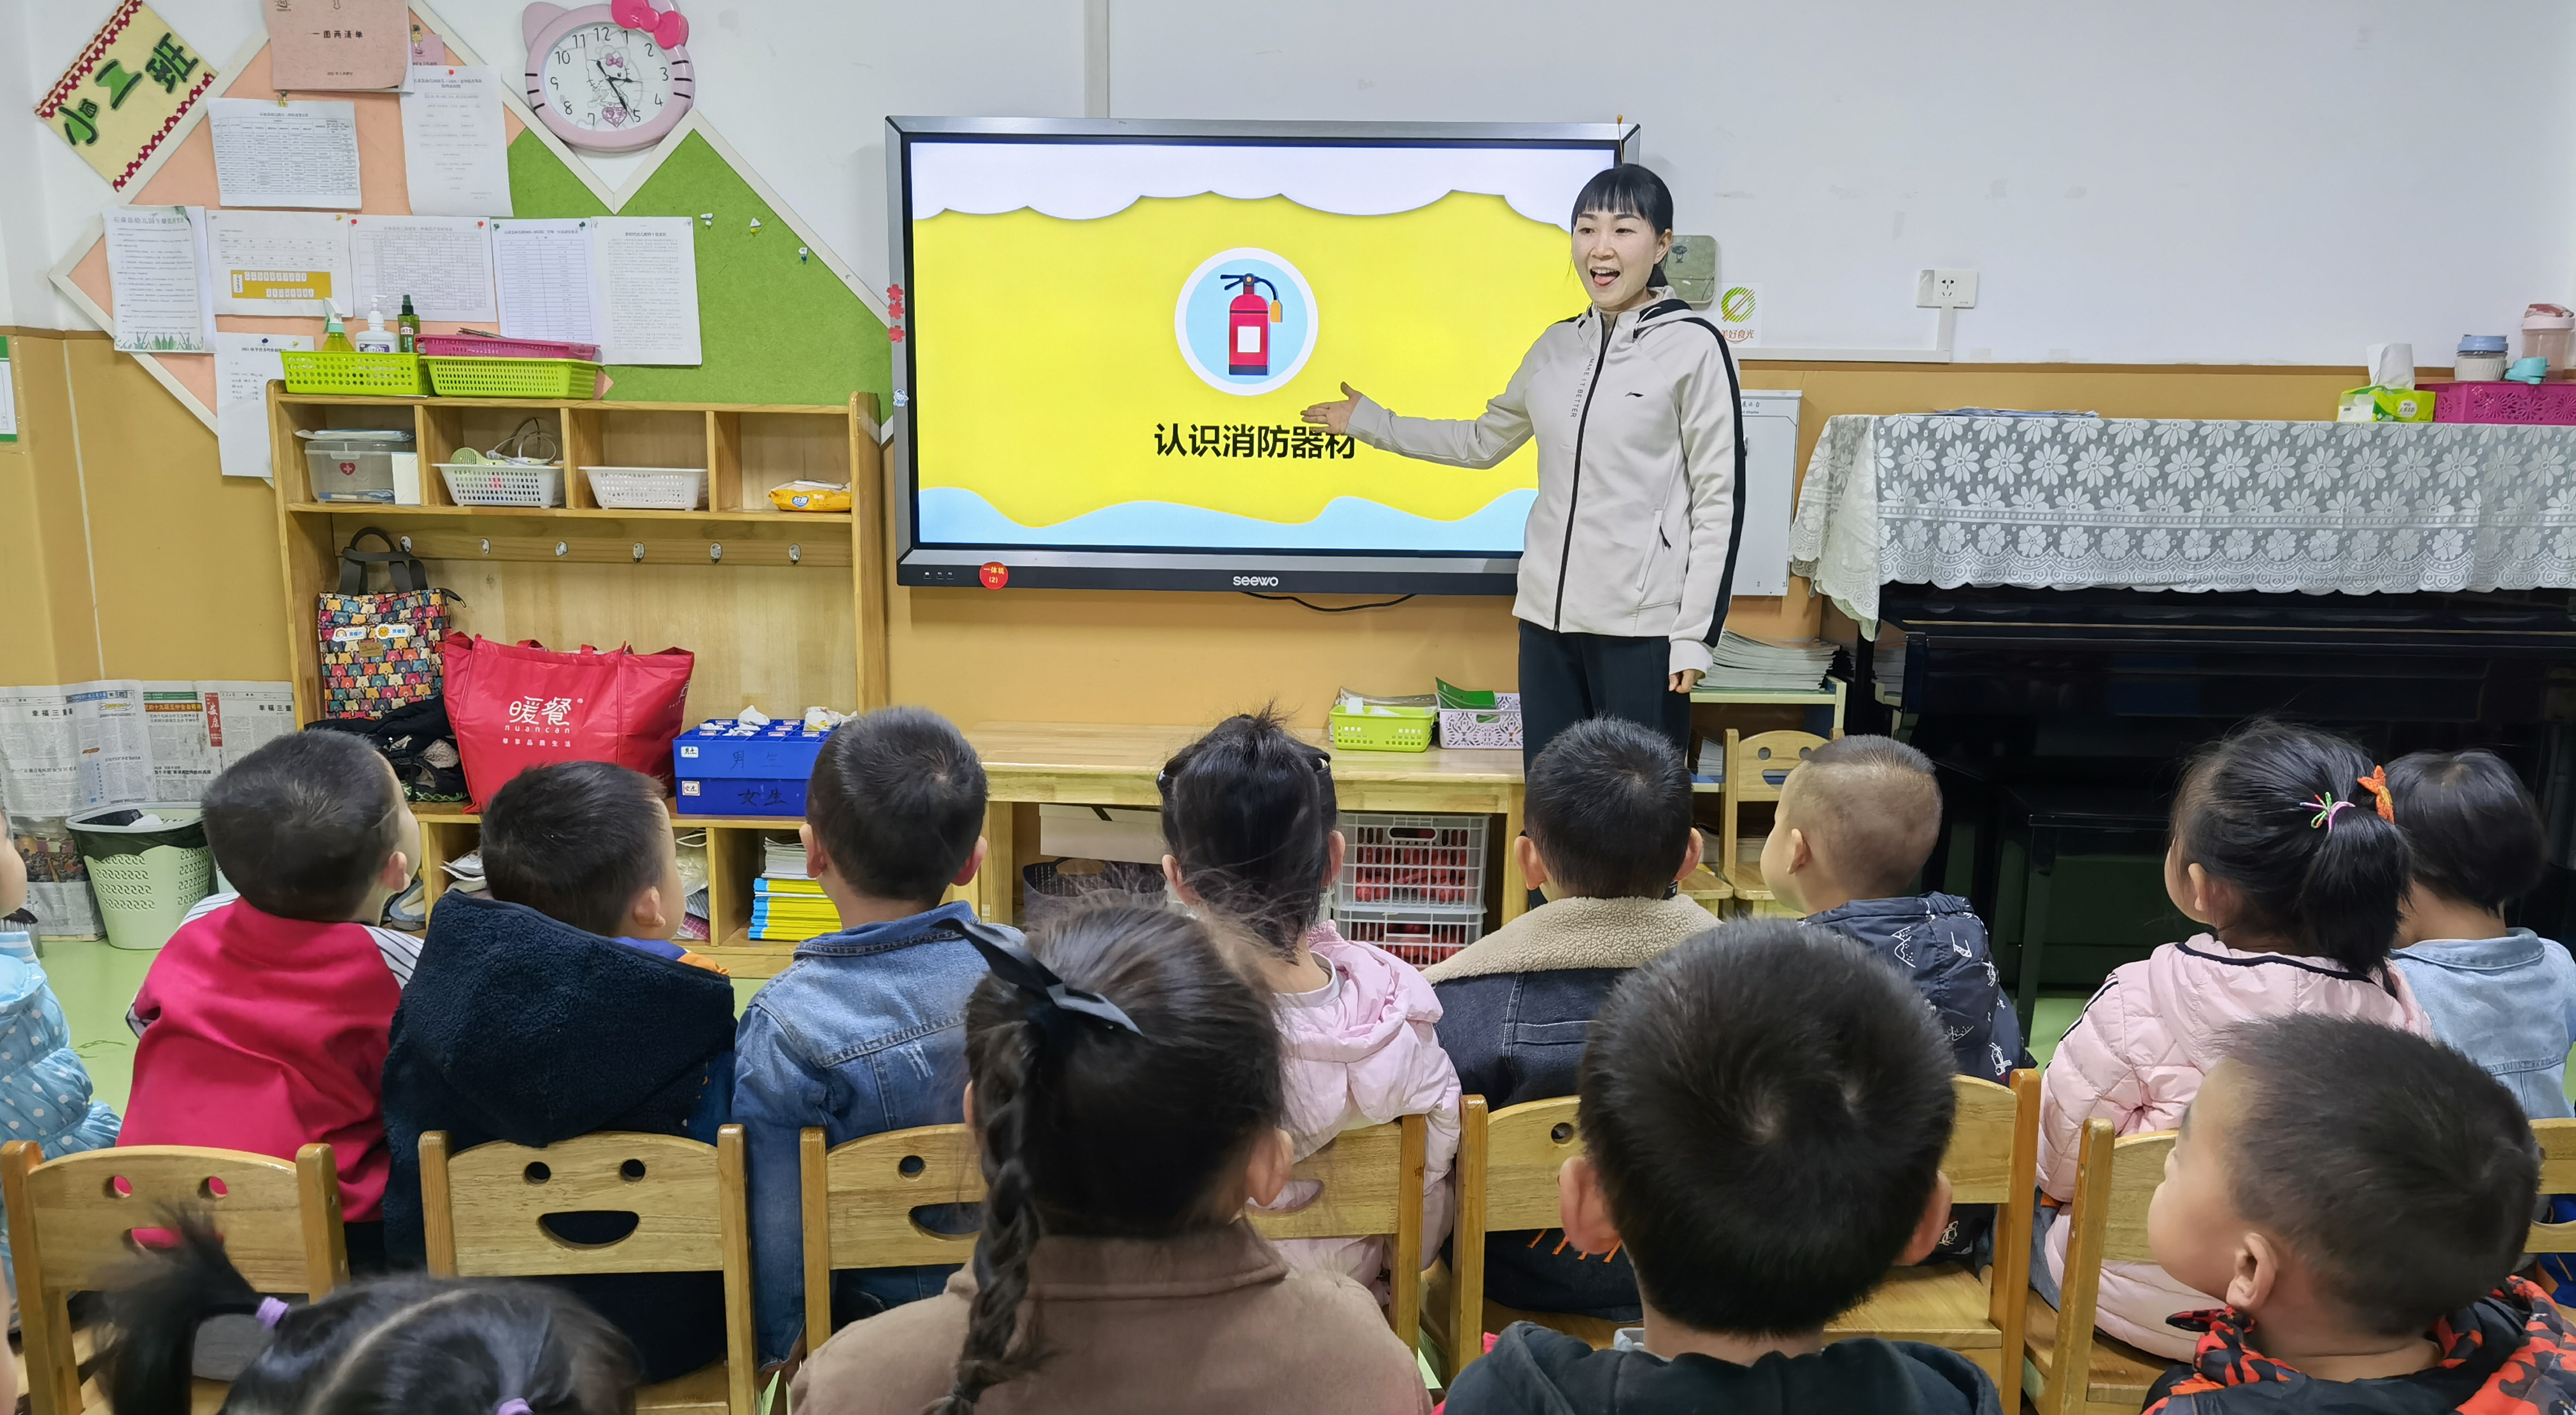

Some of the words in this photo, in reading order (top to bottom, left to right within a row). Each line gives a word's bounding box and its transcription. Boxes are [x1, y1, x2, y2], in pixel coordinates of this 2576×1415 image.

[572, 34, 586, 48] 11
[593, 27, 611, 41] 12
[623, 31, 629, 44] 1
[555, 50, 570, 64] 10
[644, 43, 654, 57] 2
[660, 67, 669, 81] 3
[59, 32, 199, 146] 小二班
[550, 77, 559, 90] 9
[655, 94, 663, 106] 4
[563, 101, 572, 115] 8
[588, 113, 595, 126] 7
[633, 109, 641, 122] 5
[1583, 358, 1595, 376] MAKE
[1570, 389, 1583, 418] BETTER
[1154, 423, 1355, 459] 认识消防器材
[983, 566, 1005, 575] 一体机
[1233, 576, 1279, 587] seewo
[509, 696, 572, 726] 暖餐
[505, 725, 570, 734] nuancan
[739, 789, 788, 806] 女生
